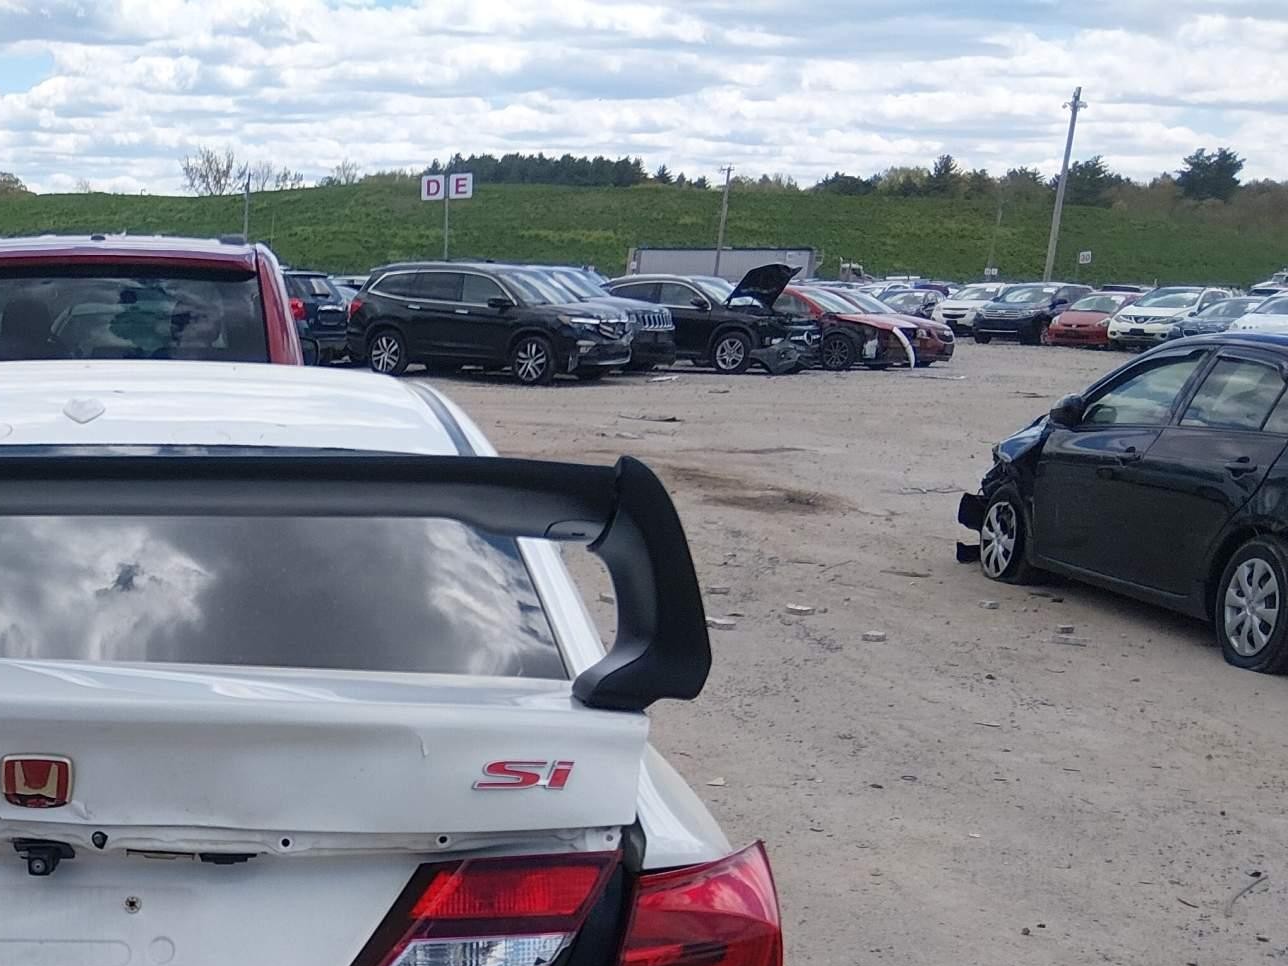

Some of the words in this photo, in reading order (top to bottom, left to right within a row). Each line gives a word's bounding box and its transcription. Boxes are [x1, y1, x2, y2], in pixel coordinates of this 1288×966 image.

[426, 179, 441, 196] D
[455, 177, 468, 195] E
[472, 760, 576, 791] Si
